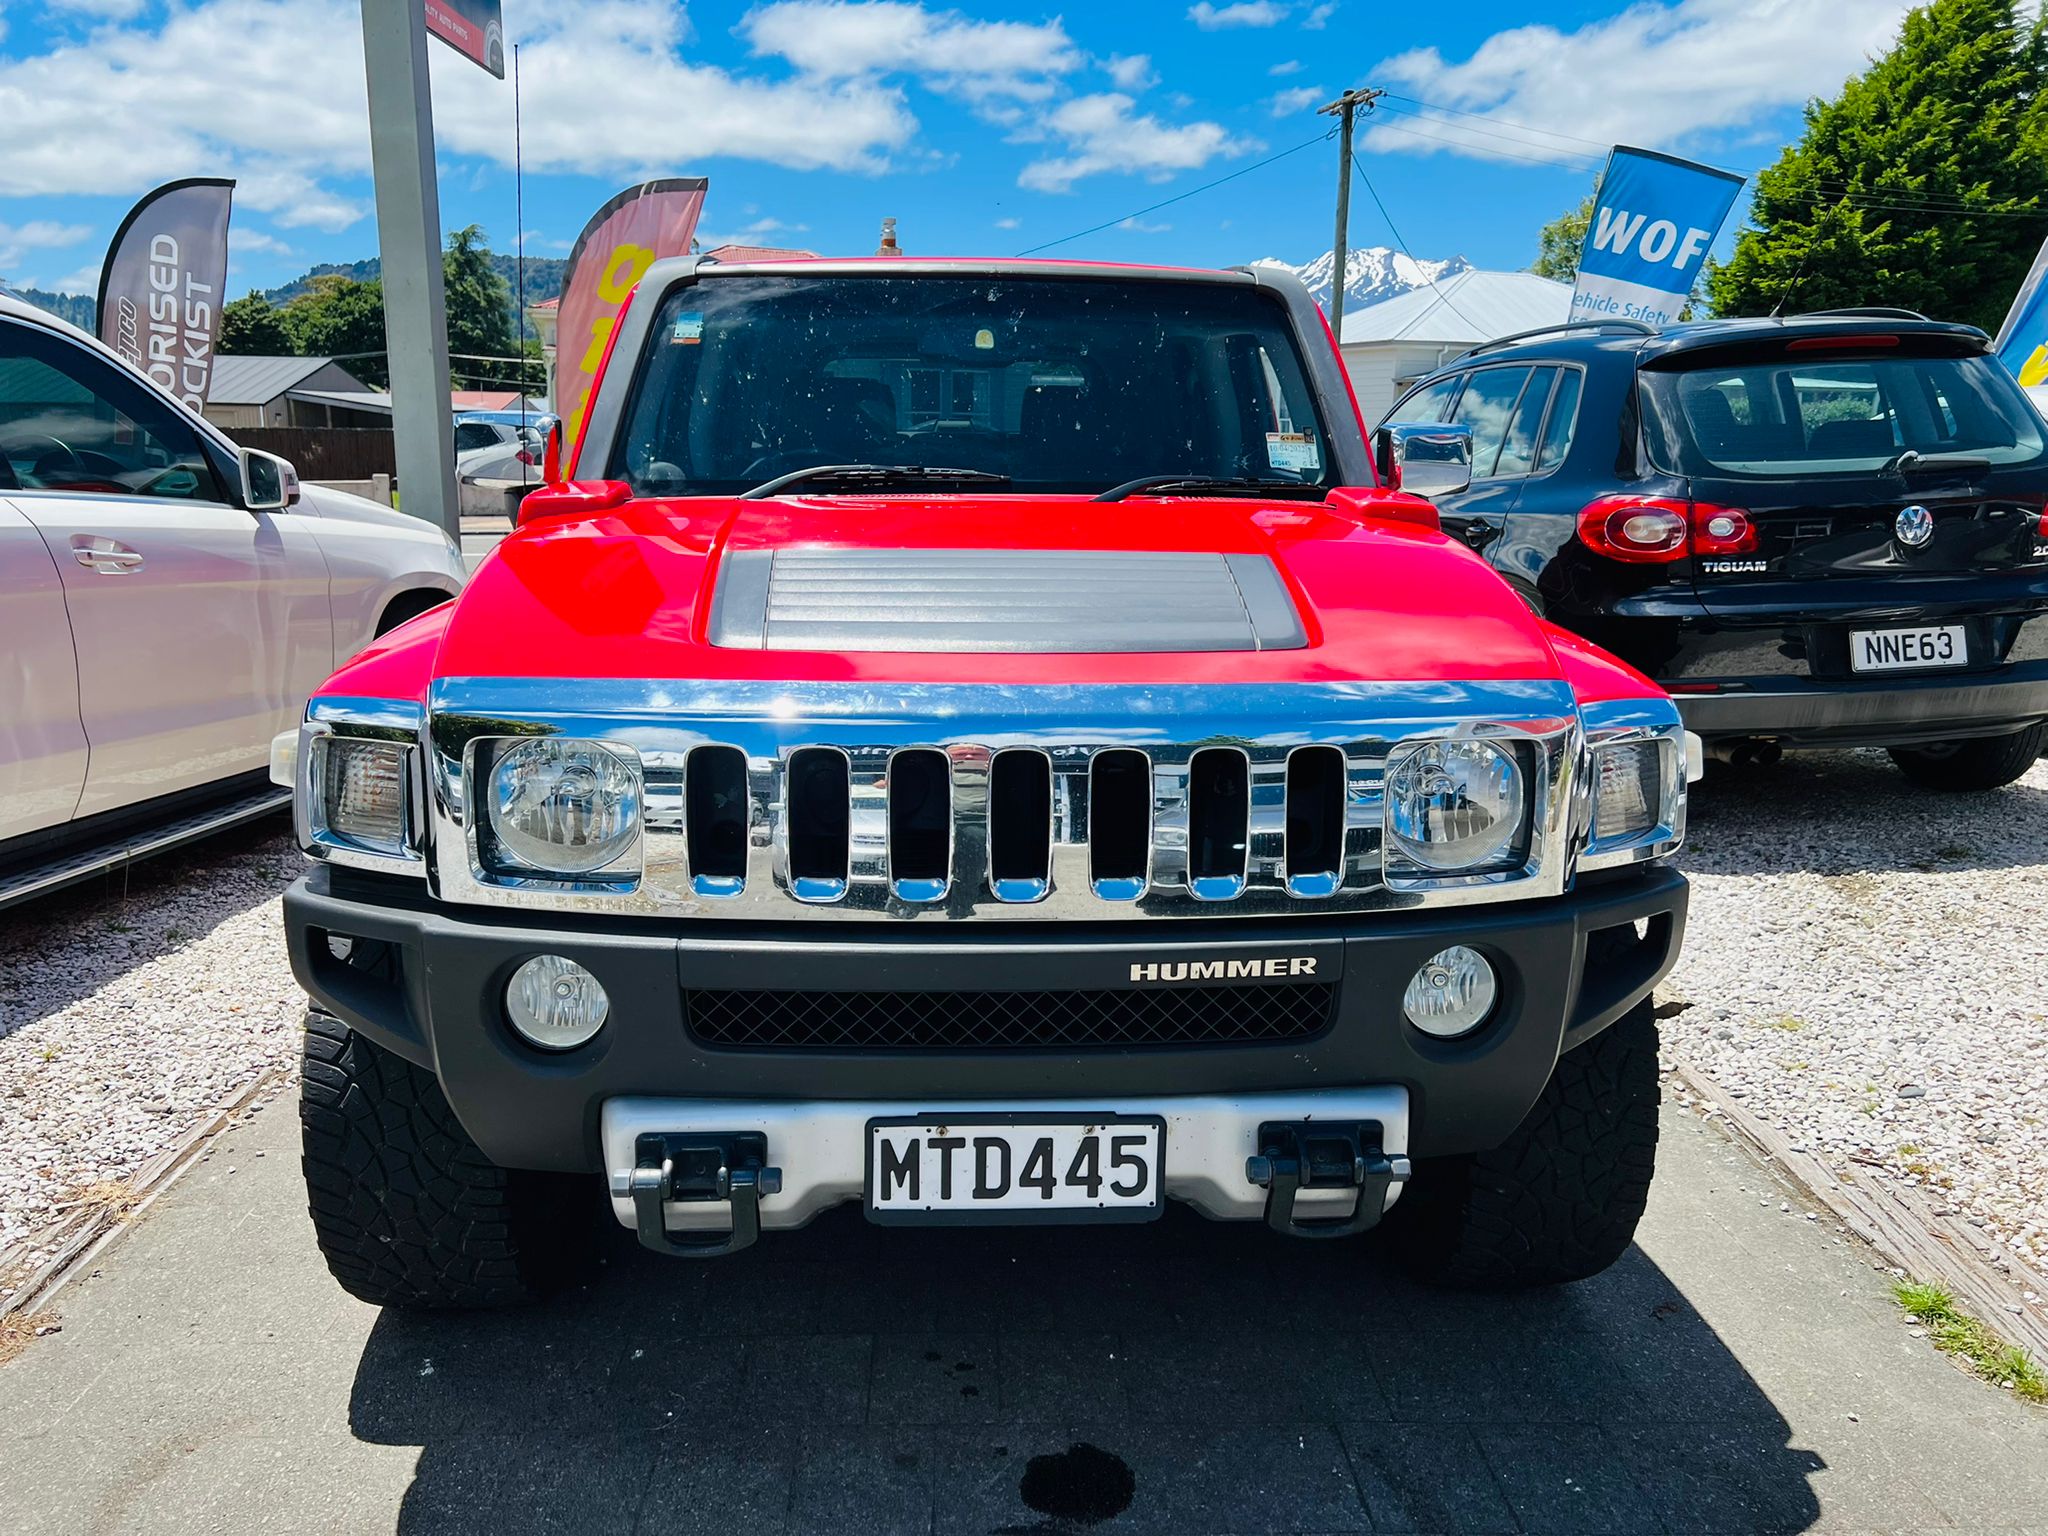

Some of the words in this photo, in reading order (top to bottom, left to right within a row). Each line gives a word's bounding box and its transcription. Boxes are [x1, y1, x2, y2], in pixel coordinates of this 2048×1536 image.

[1592, 206, 1711, 270] WOF
[147, 233, 179, 393] ORISED
[1622, 303, 1671, 325] Safety
[1702, 560, 1767, 573] TIGUAN
[1865, 631, 1954, 665] NNE63
[1130, 957, 1318, 981] HUMMER
[880, 1136, 1149, 1201] MTD445
